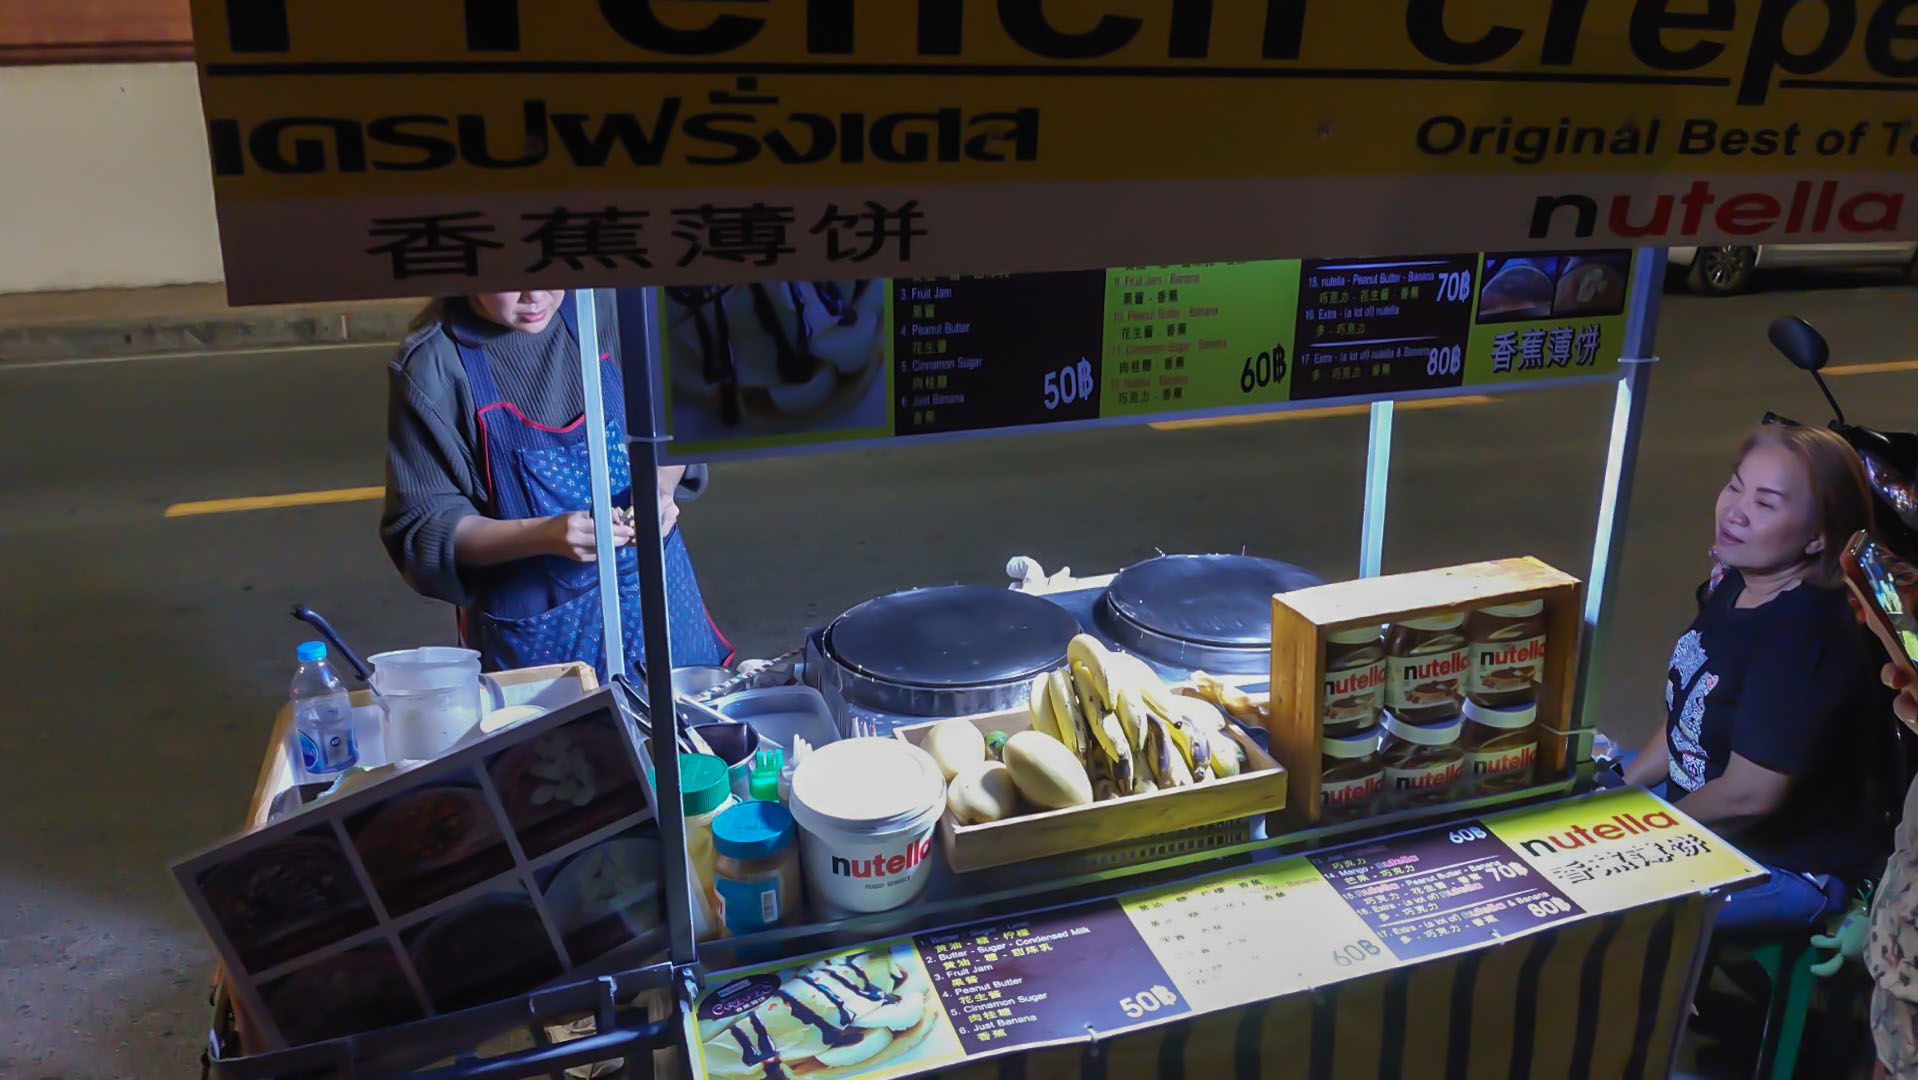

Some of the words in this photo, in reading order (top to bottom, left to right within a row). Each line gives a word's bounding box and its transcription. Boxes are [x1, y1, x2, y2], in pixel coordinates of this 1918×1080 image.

[1416, 115, 1660, 165] Original
[1677, 118, 1801, 156] Best
[1815, 120, 1871, 156] of
[1528, 180, 1905, 239] nutella
[365, 200, 928, 280] 香蕉薄饼
[1408, 270, 1435, 283] Banana
[911, 286, 931, 301] Fruit
[934, 285, 953, 300] Jam
[912, 322, 943, 337] Peanut
[944, 320, 971, 335] Butter
[1491, 323, 1601, 373] 香蕉薄饼
[1519, 811, 1680, 857] nutella
[864, 882, 885, 890] FOOD
[1405, 875, 1437, 887] Peanut
[1517, 890, 1551, 904] Banana
[938, 949, 968, 962] Butter
[977, 942, 1006, 955] Sugar
[1015, 930, 1069, 947] Condensed
[1071, 925, 1091, 937] Milk
[946, 967, 970, 979] Fruit
[972, 962, 994, 974] Jam
[955, 983, 992, 996] Peanut
[993, 976, 1023, 989] Butter
[963, 998, 1016, 1014] Cinnamon
[1017, 991, 1048, 1004] Sugar
[973, 1022, 996, 1033] Just
[997, 1013, 1037, 1027] Banana
